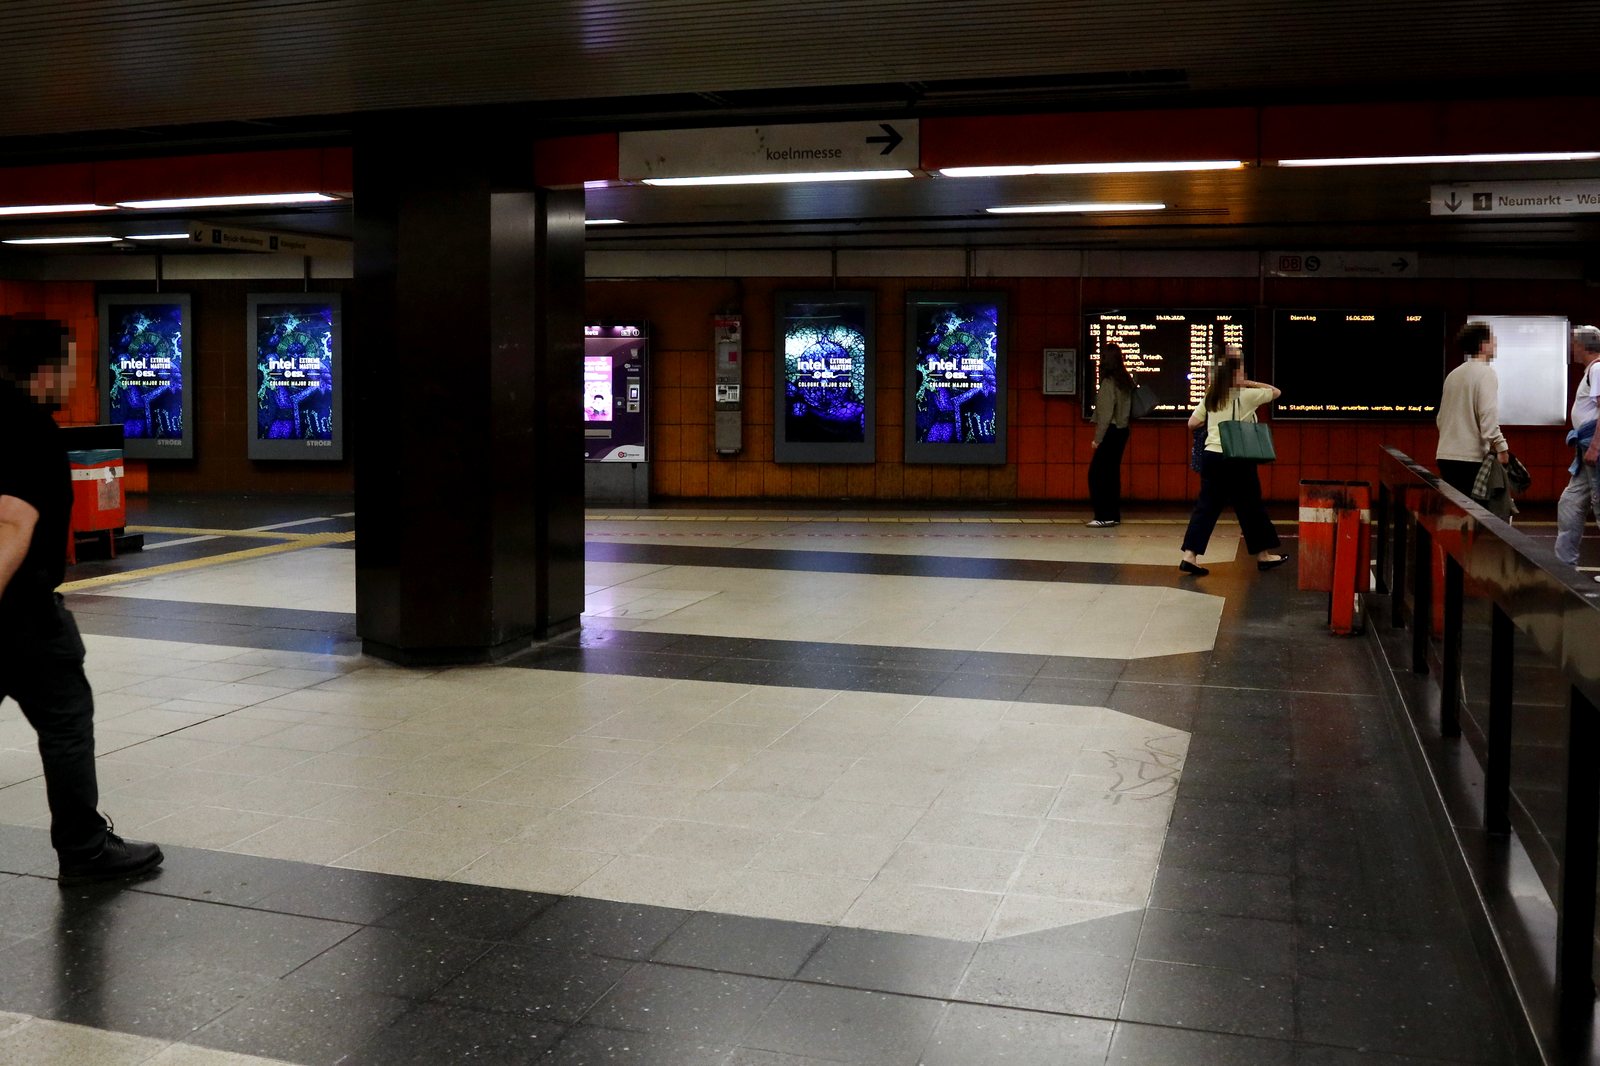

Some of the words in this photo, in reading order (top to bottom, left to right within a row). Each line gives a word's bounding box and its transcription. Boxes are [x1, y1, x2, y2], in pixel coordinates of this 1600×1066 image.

[766, 147, 842, 160] koelnmesse
[1478, 194, 1487, 209] 1
[1498, 195, 1561, 207] Neumarkt
[1282, 258, 1299, 269] DB
[306, 439, 332, 447] STRÖER
